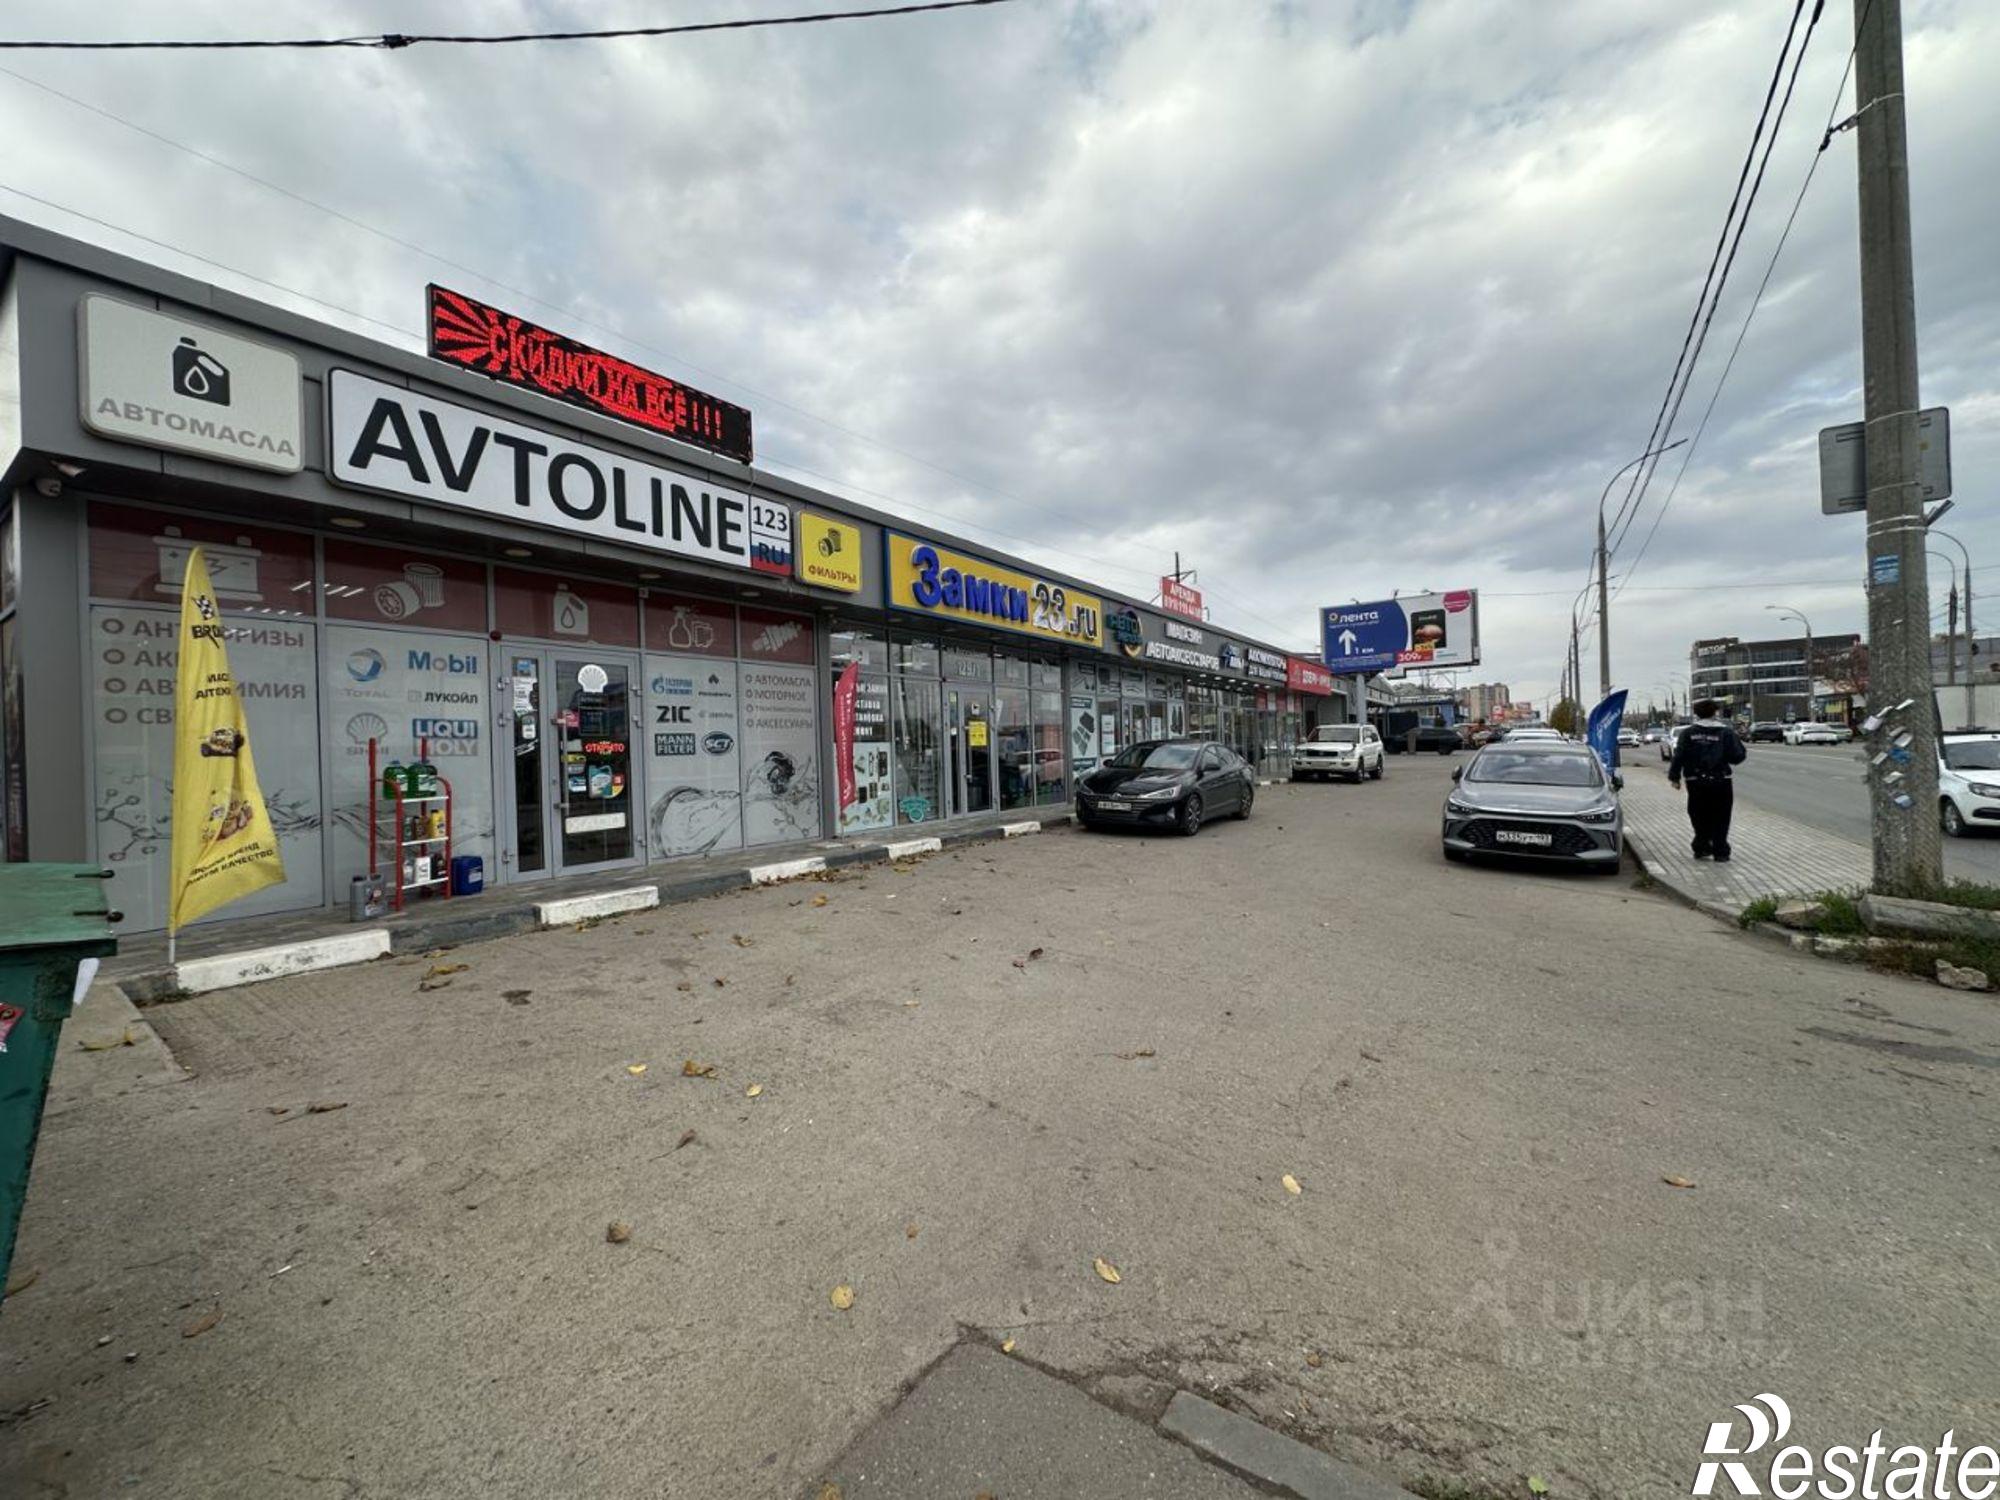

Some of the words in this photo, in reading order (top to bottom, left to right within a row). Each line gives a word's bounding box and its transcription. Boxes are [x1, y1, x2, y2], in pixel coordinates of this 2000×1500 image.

[607, 367, 640, 412] НА
[97, 397, 295, 458] АВТОМАСЛА
[347, 396, 746, 557] AVTOLINE
[753, 505, 788, 532] 123
[758, 541, 785, 565] RU
[807, 564, 857, 585] ФИЛЬТРЫ
[407, 650, 478, 674] Mobil
[424, 690, 479, 704] ЛУКОЙЛ
[656, 705, 692, 724] ZIC
[415, 720, 476, 737] LIQUI
[657, 734, 695, 744] MANN
[658, 744, 696, 754] FILTER
